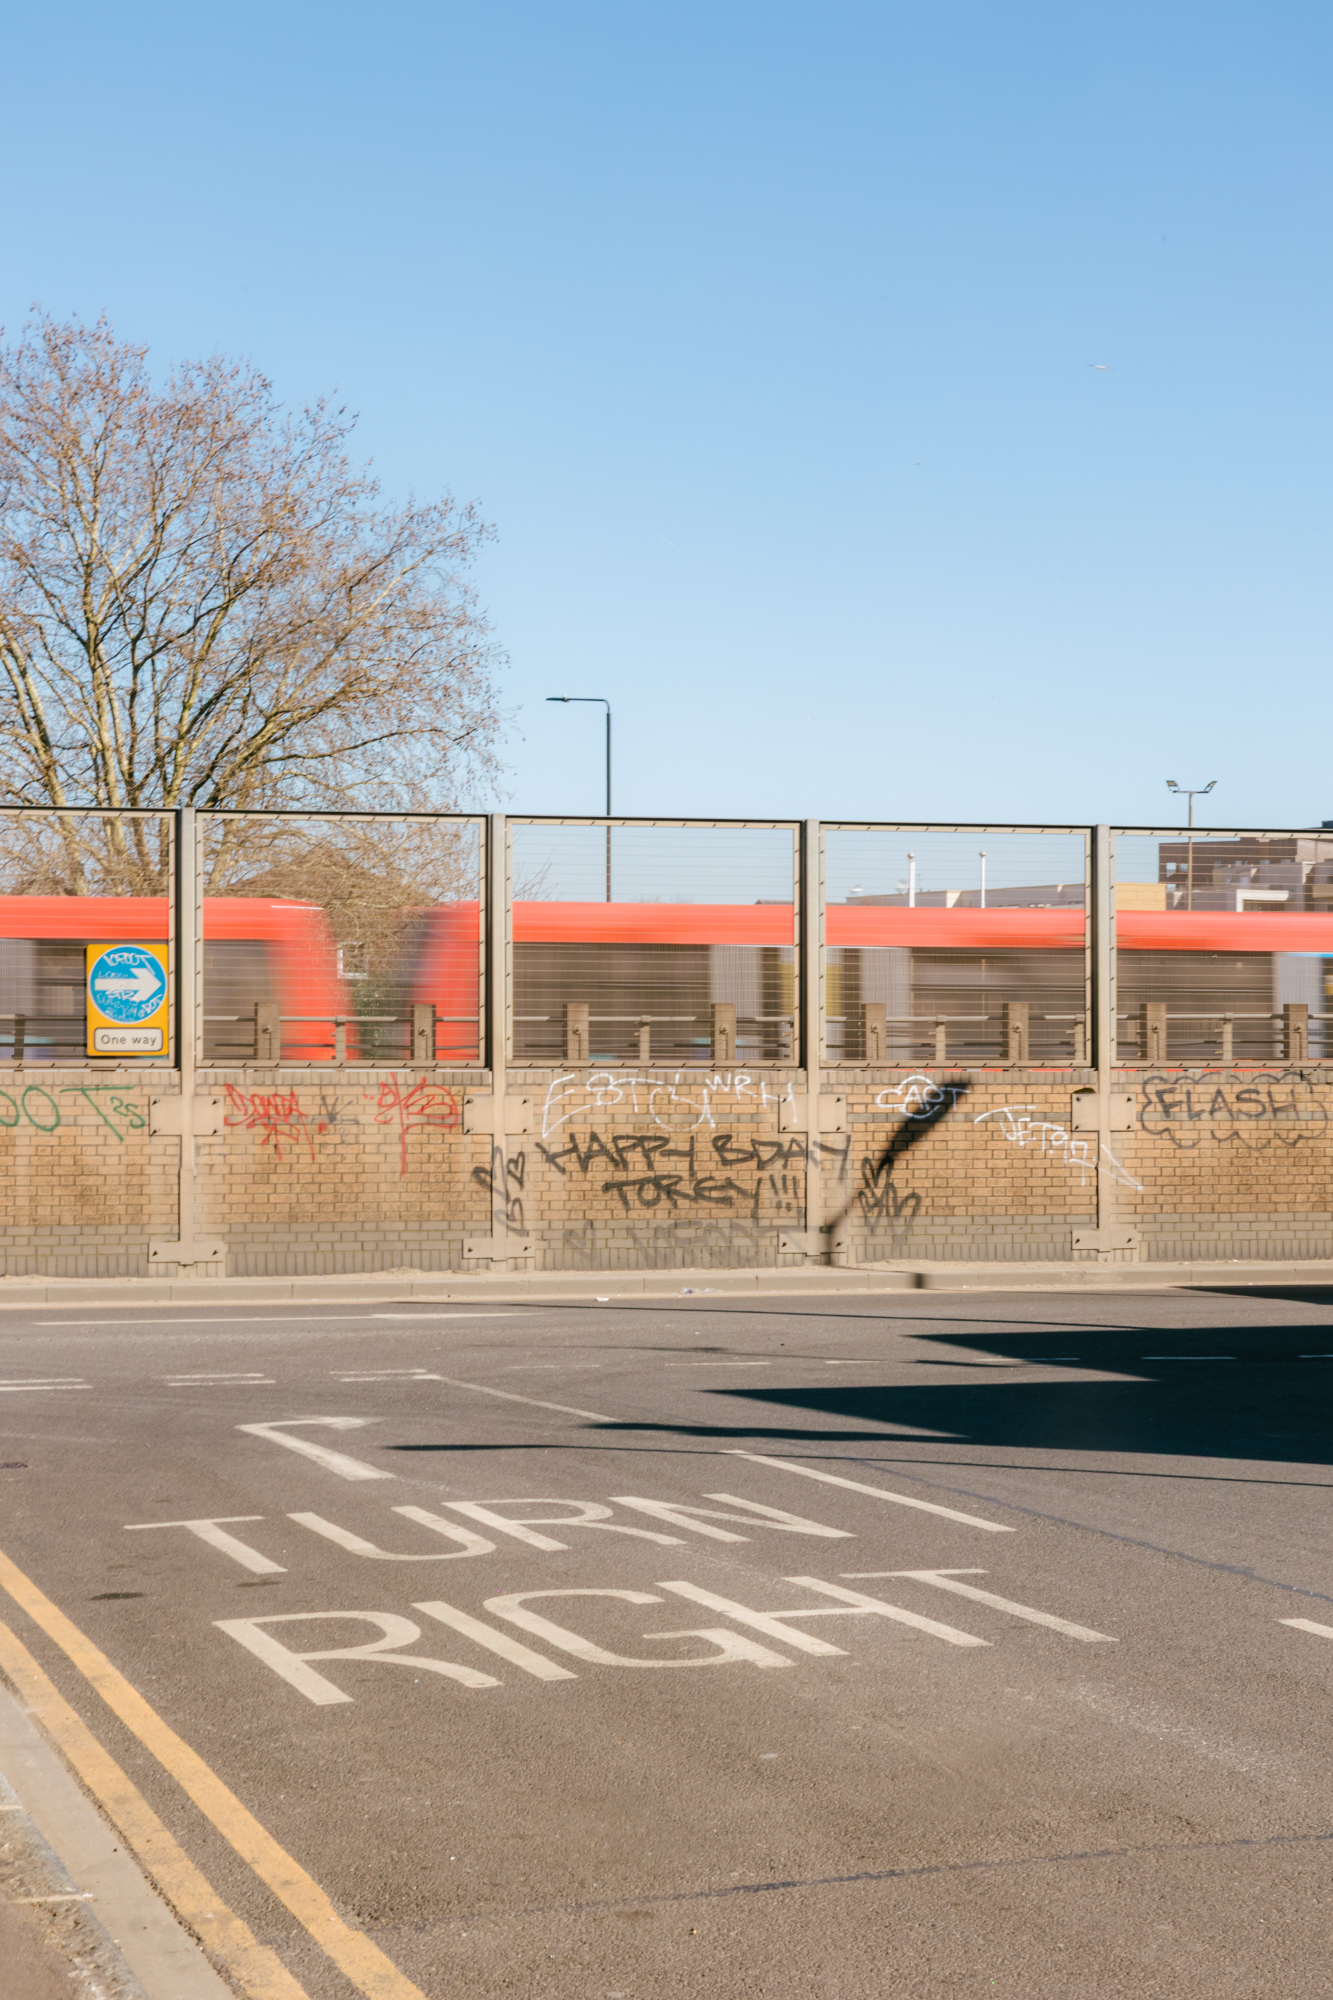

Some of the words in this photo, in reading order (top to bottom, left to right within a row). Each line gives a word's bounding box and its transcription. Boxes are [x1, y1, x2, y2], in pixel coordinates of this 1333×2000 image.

[101, 1034, 127, 1045] One
[131, 1035, 157, 1047] way
[1155, 1087, 1300, 1121] FLASH
[535, 1131, 695, 1179] HAPPY
[711, 1133, 850, 1184] BDAY
[123, 1492, 858, 1575] TURN
[213, 1567, 1120, 1707] RIGHT
